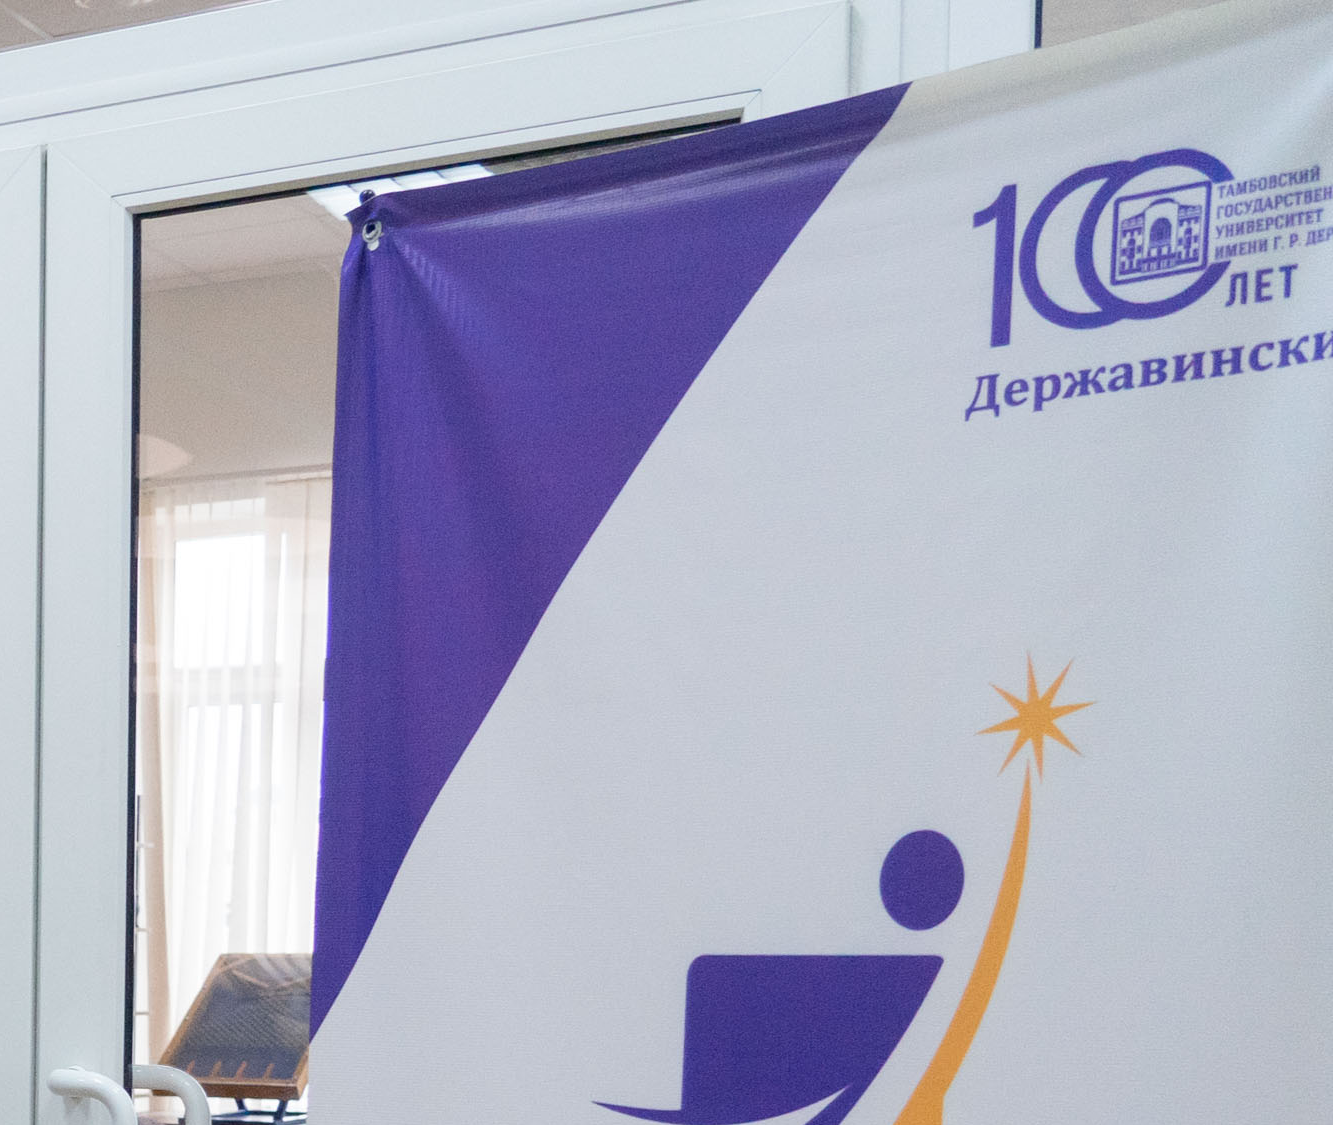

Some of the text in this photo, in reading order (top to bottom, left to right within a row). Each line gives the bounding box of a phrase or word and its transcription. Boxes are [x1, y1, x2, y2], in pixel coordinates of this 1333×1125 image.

[1217, 165, 1320, 200] ТАМБОВСКИЙ
[1215, 208, 1323, 239] УНИВЕРСИТЕТ
[1214, 239, 1268, 260] ИМЕНИ
[1224, 263, 1298, 308] ЛЕТ
